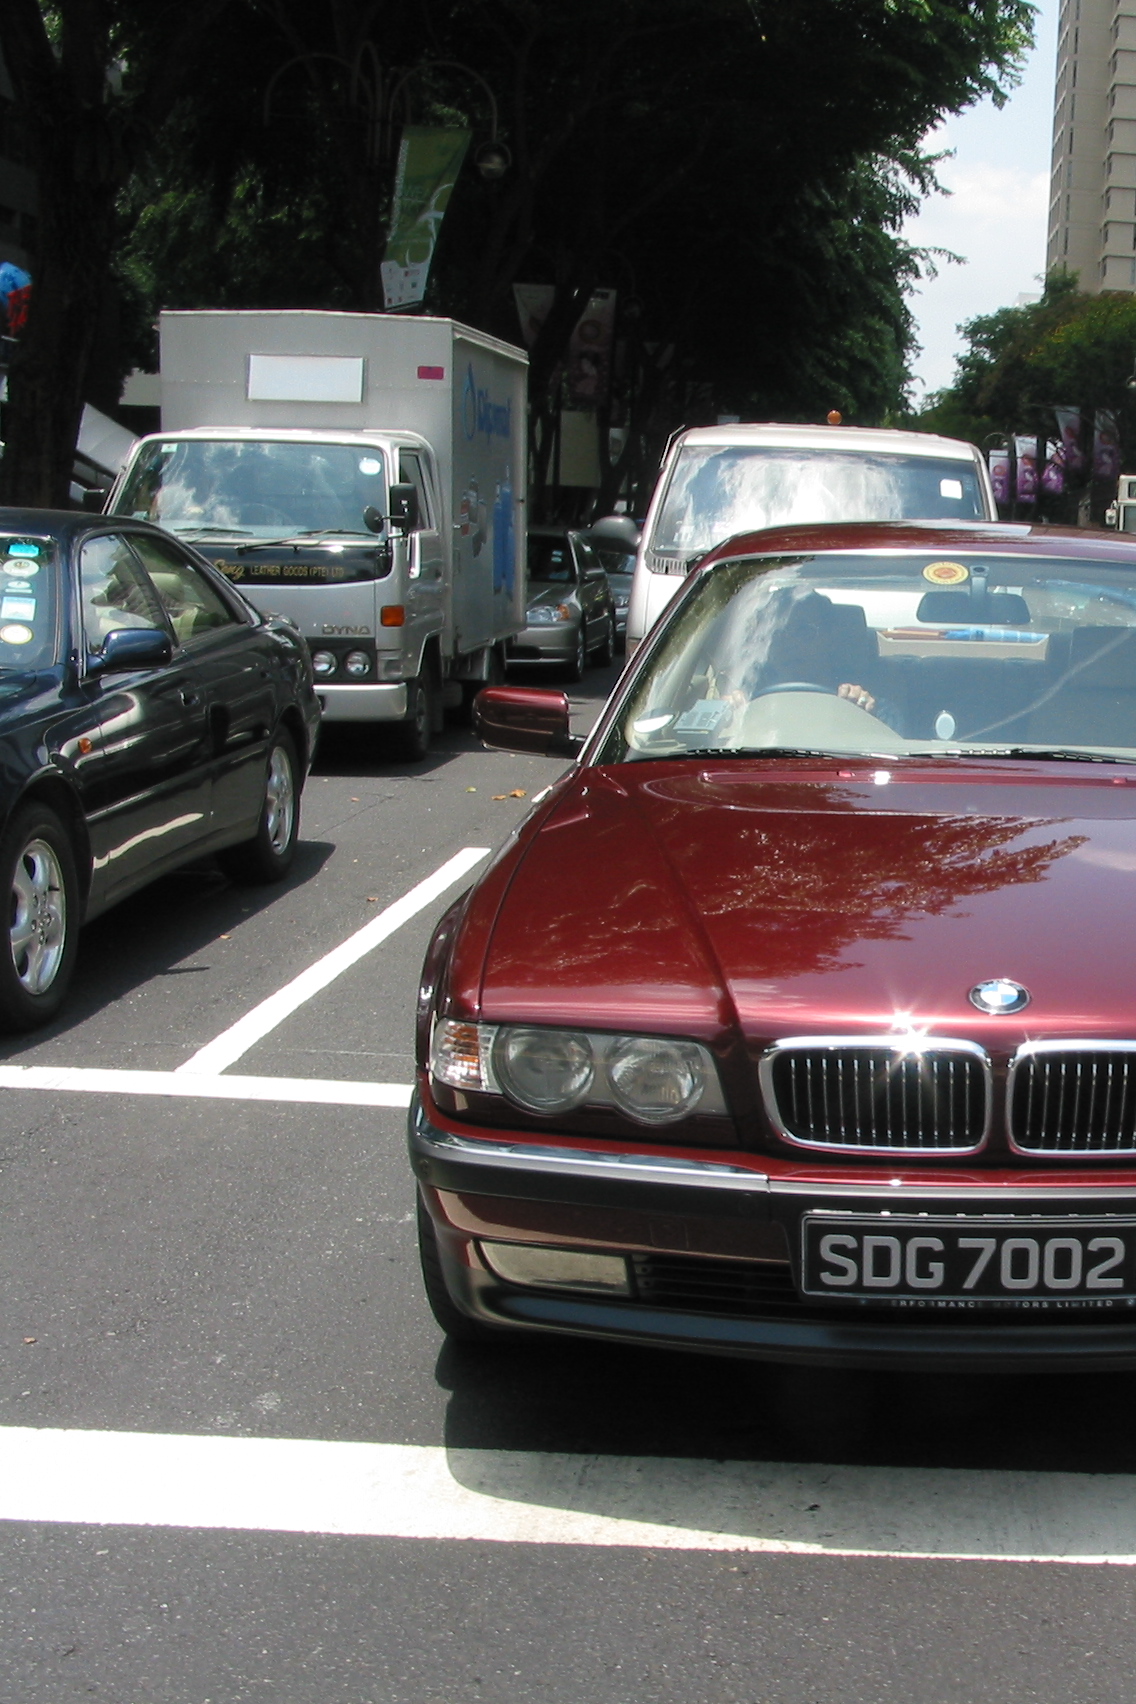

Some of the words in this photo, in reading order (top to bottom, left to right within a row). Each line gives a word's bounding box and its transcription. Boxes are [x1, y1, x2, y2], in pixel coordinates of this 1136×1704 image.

[250, 565, 281, 576] LEATHER
[282, 565, 309, 577] GOODS
[322, 625, 371, 635] DYNA
[819, 1234, 945, 1289] SDG
[957, 1237, 1126, 1290] 7002
[883, 1300, 984, 1309] RFOMANC
